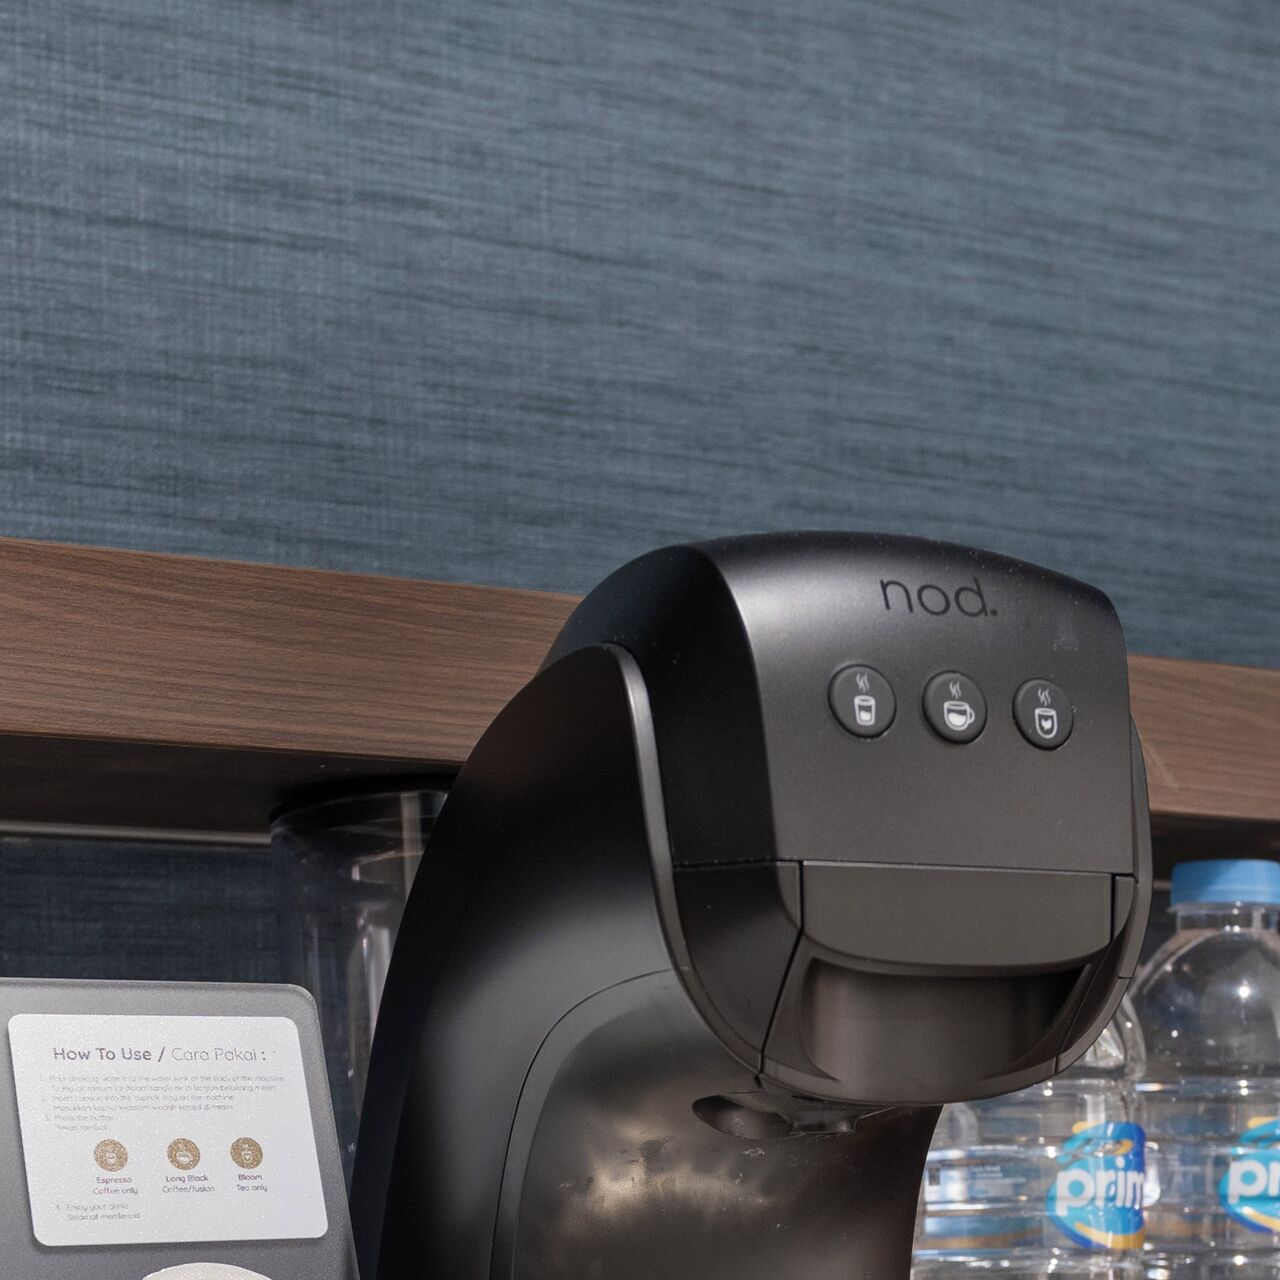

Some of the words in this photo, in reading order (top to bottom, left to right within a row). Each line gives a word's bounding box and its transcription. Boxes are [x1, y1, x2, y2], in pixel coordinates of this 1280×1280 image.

[880, 576, 998, 617] nod.
[53, 1047, 90, 1061] How
[96, 1047, 116, 1061] To
[121, 1047, 152, 1061] Use
[171, 1048, 210, 1062] Cara
[96, 1176, 132, 1185] Espresso
[166, 1175, 185, 1183] Long
[187, 1174, 209, 1182] Black
[238, 1174, 263, 1182] Bloom
[92, 1187, 120, 1195] Coffee
[121, 1186, 138, 1195] only
[236, 1184, 250, 1192] Tea
[251, 1184, 268, 1193] only
